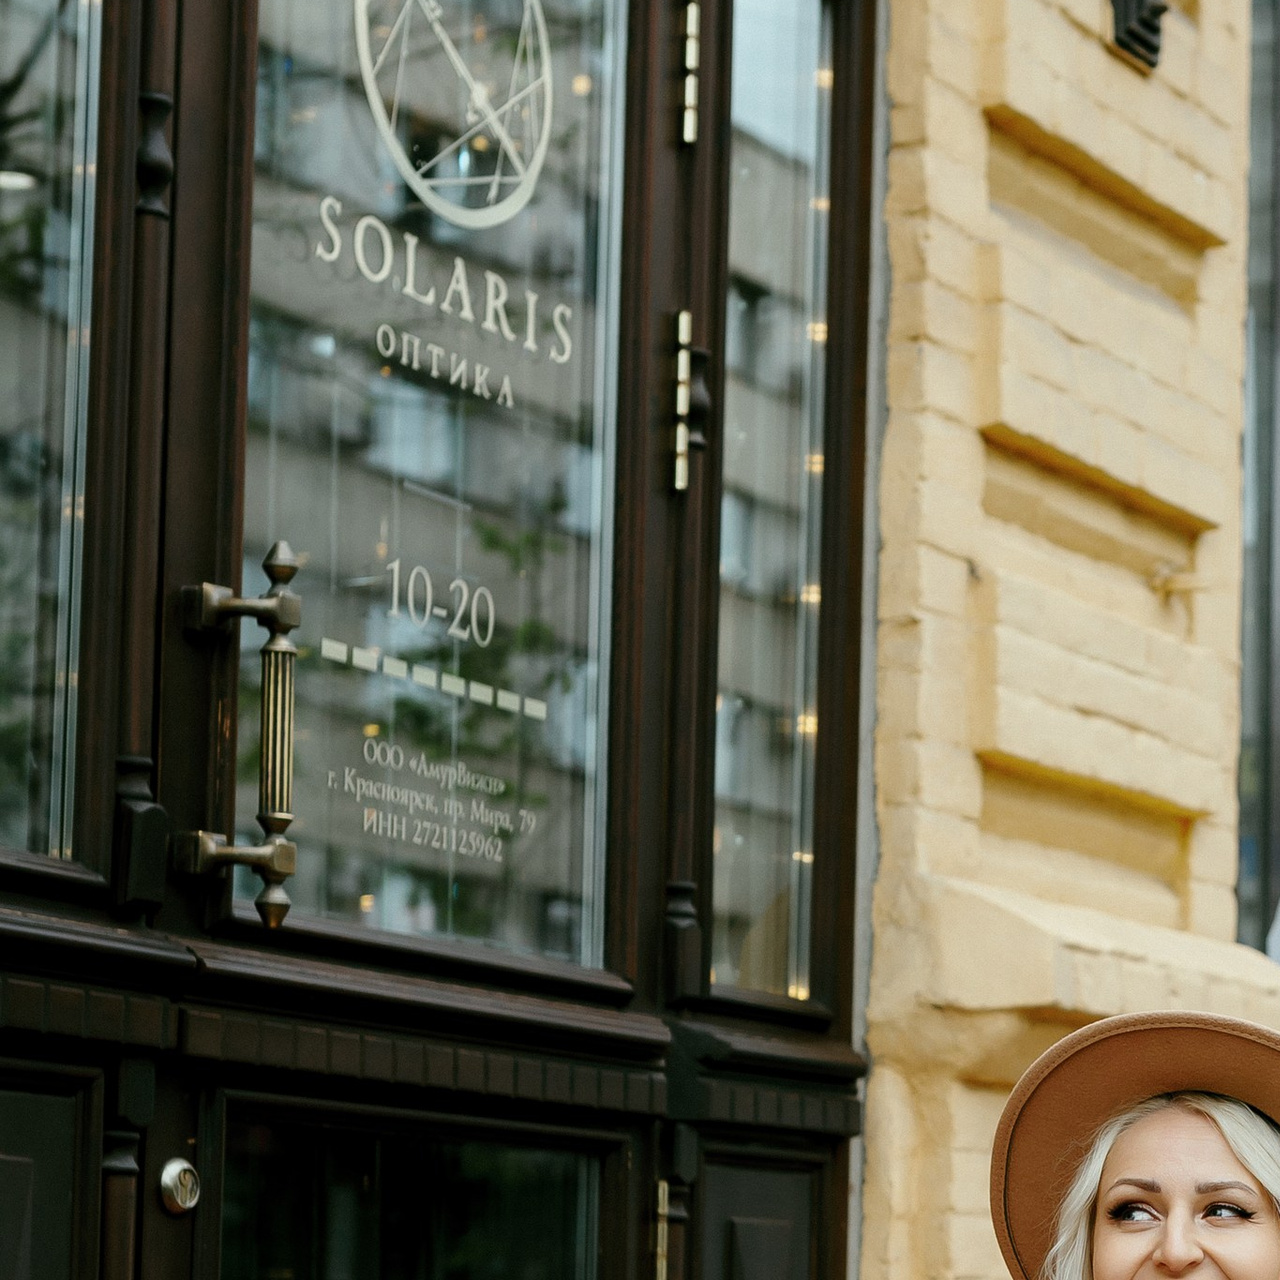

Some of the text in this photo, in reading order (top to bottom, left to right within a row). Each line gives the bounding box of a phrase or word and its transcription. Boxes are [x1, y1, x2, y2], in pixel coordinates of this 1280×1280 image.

[315, 195, 573, 364] SOLARIS
[376, 323, 515, 409] ОПТИКА
[386, 557, 495, 648] 10-20
[363, 737, 404, 771] ООО
[327, 766, 537, 835] г. Красноярск, пр. Мира, 79
[363, 806, 503, 862] ИНН 2721125962
